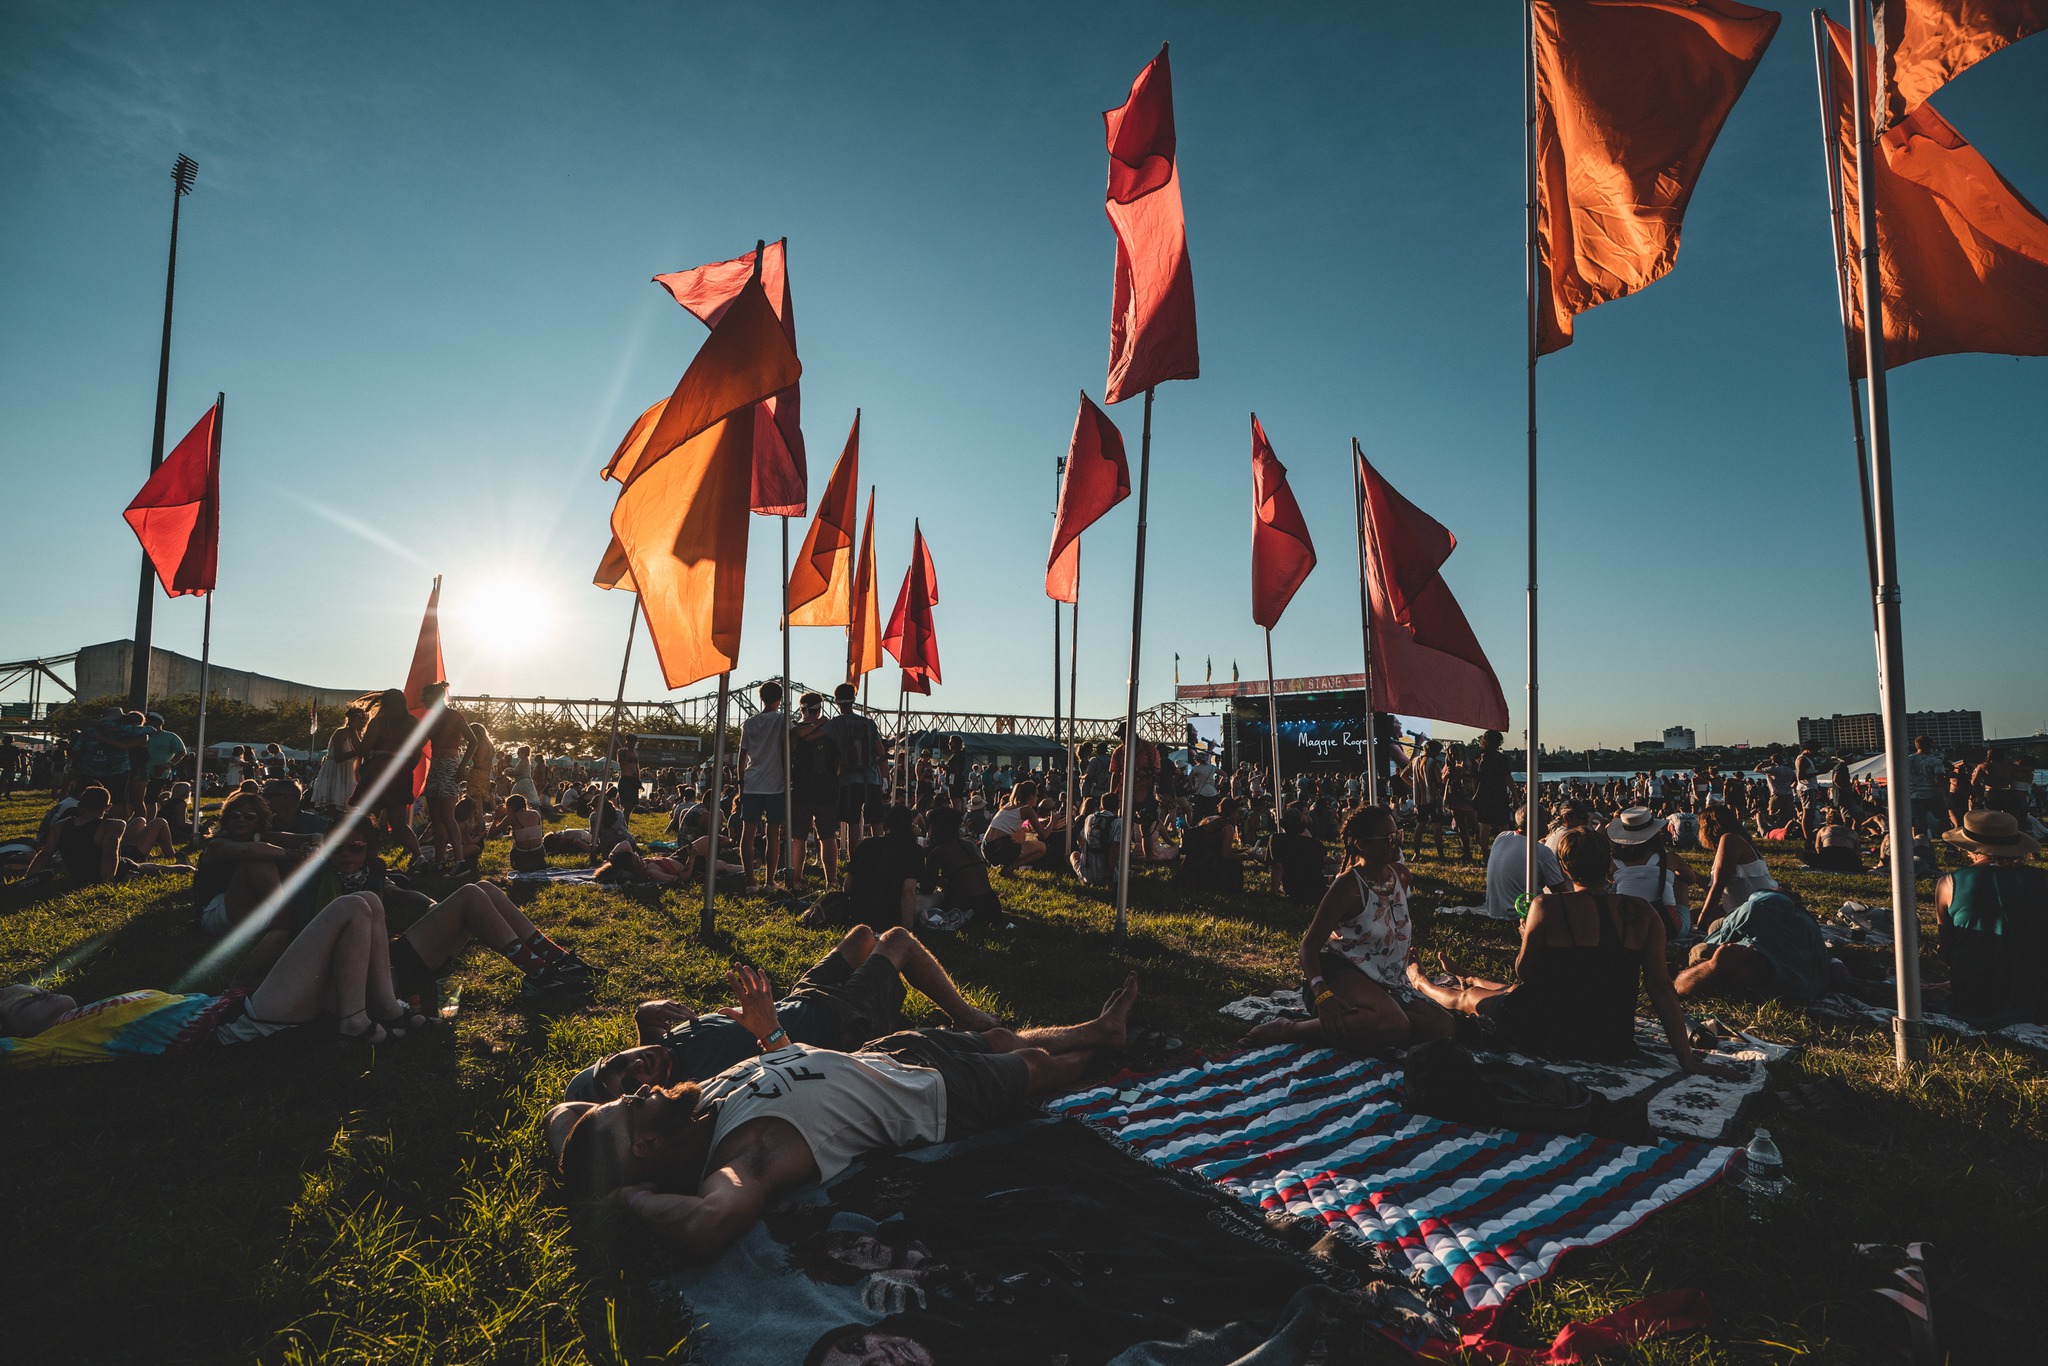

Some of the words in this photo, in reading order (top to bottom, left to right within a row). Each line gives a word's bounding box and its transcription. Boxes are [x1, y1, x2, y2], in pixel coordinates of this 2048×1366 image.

[1308, 677, 1341, 689] STAGE
[1298, 732, 1338, 755] Maggie
[1343, 732, 1378, 754] Roges
[1221, 1205, 1261, 1230] Family
